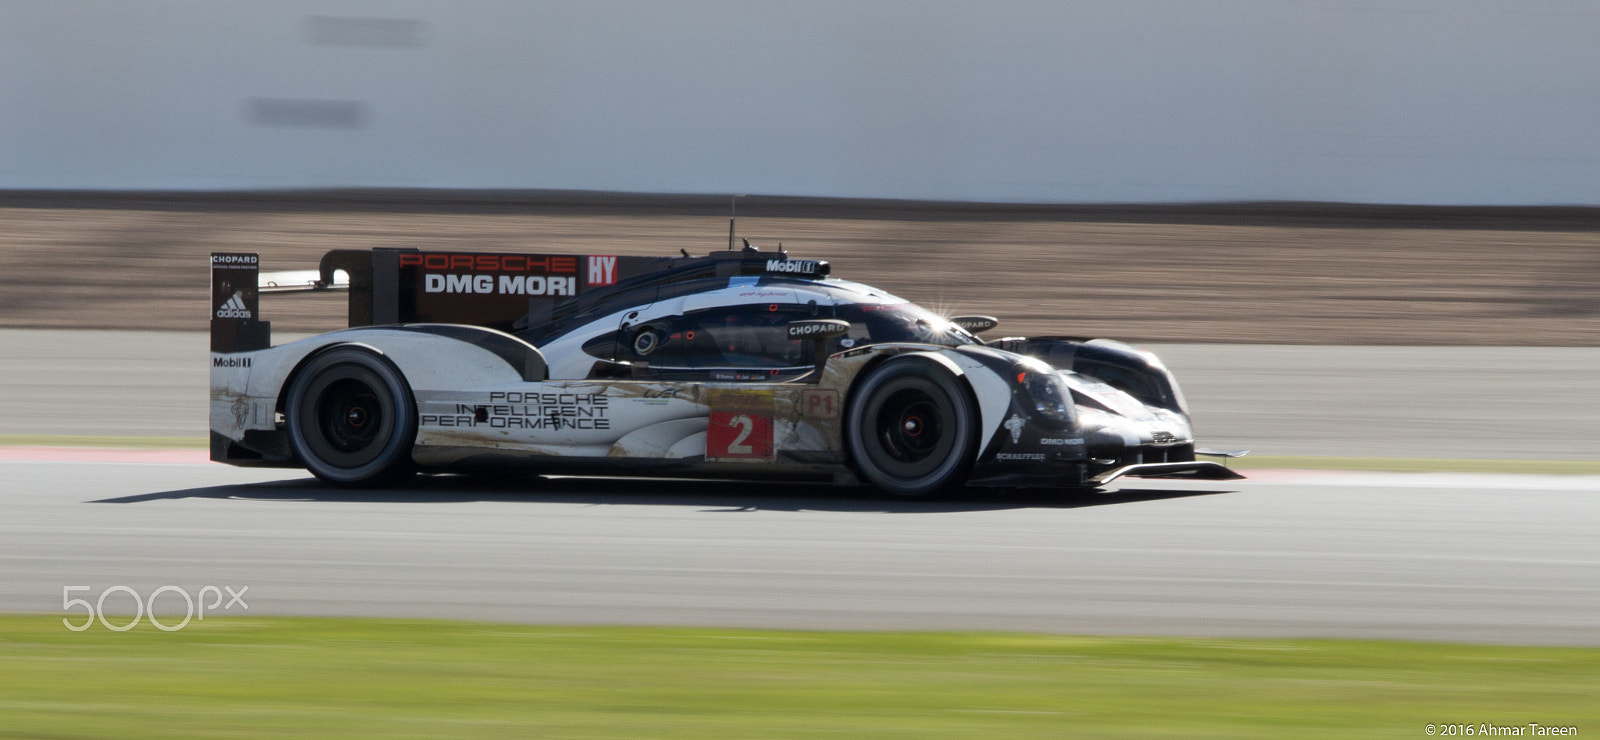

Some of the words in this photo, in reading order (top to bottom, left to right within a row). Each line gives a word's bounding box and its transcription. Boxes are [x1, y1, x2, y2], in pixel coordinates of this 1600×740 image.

[400, 254, 576, 272] PORSCHE
[766, 260, 802, 273] Mobil
[589, 256, 616, 285] HY
[425, 274, 494, 294] DMG
[498, 275, 576, 296] MORI
[216, 309, 251, 319] adidas
[789, 324, 845, 335] CHOPARD
[957, 321, 991, 329] OPARD
[213, 357, 241, 367] Mobil
[490, 392, 608, 405] PORSCHE
[808, 395, 832, 415] P1
[456, 404, 609, 417] INTELLIGENT
[422, 415, 610, 430] PERFORMANCE
[727, 415, 753, 454] 2
